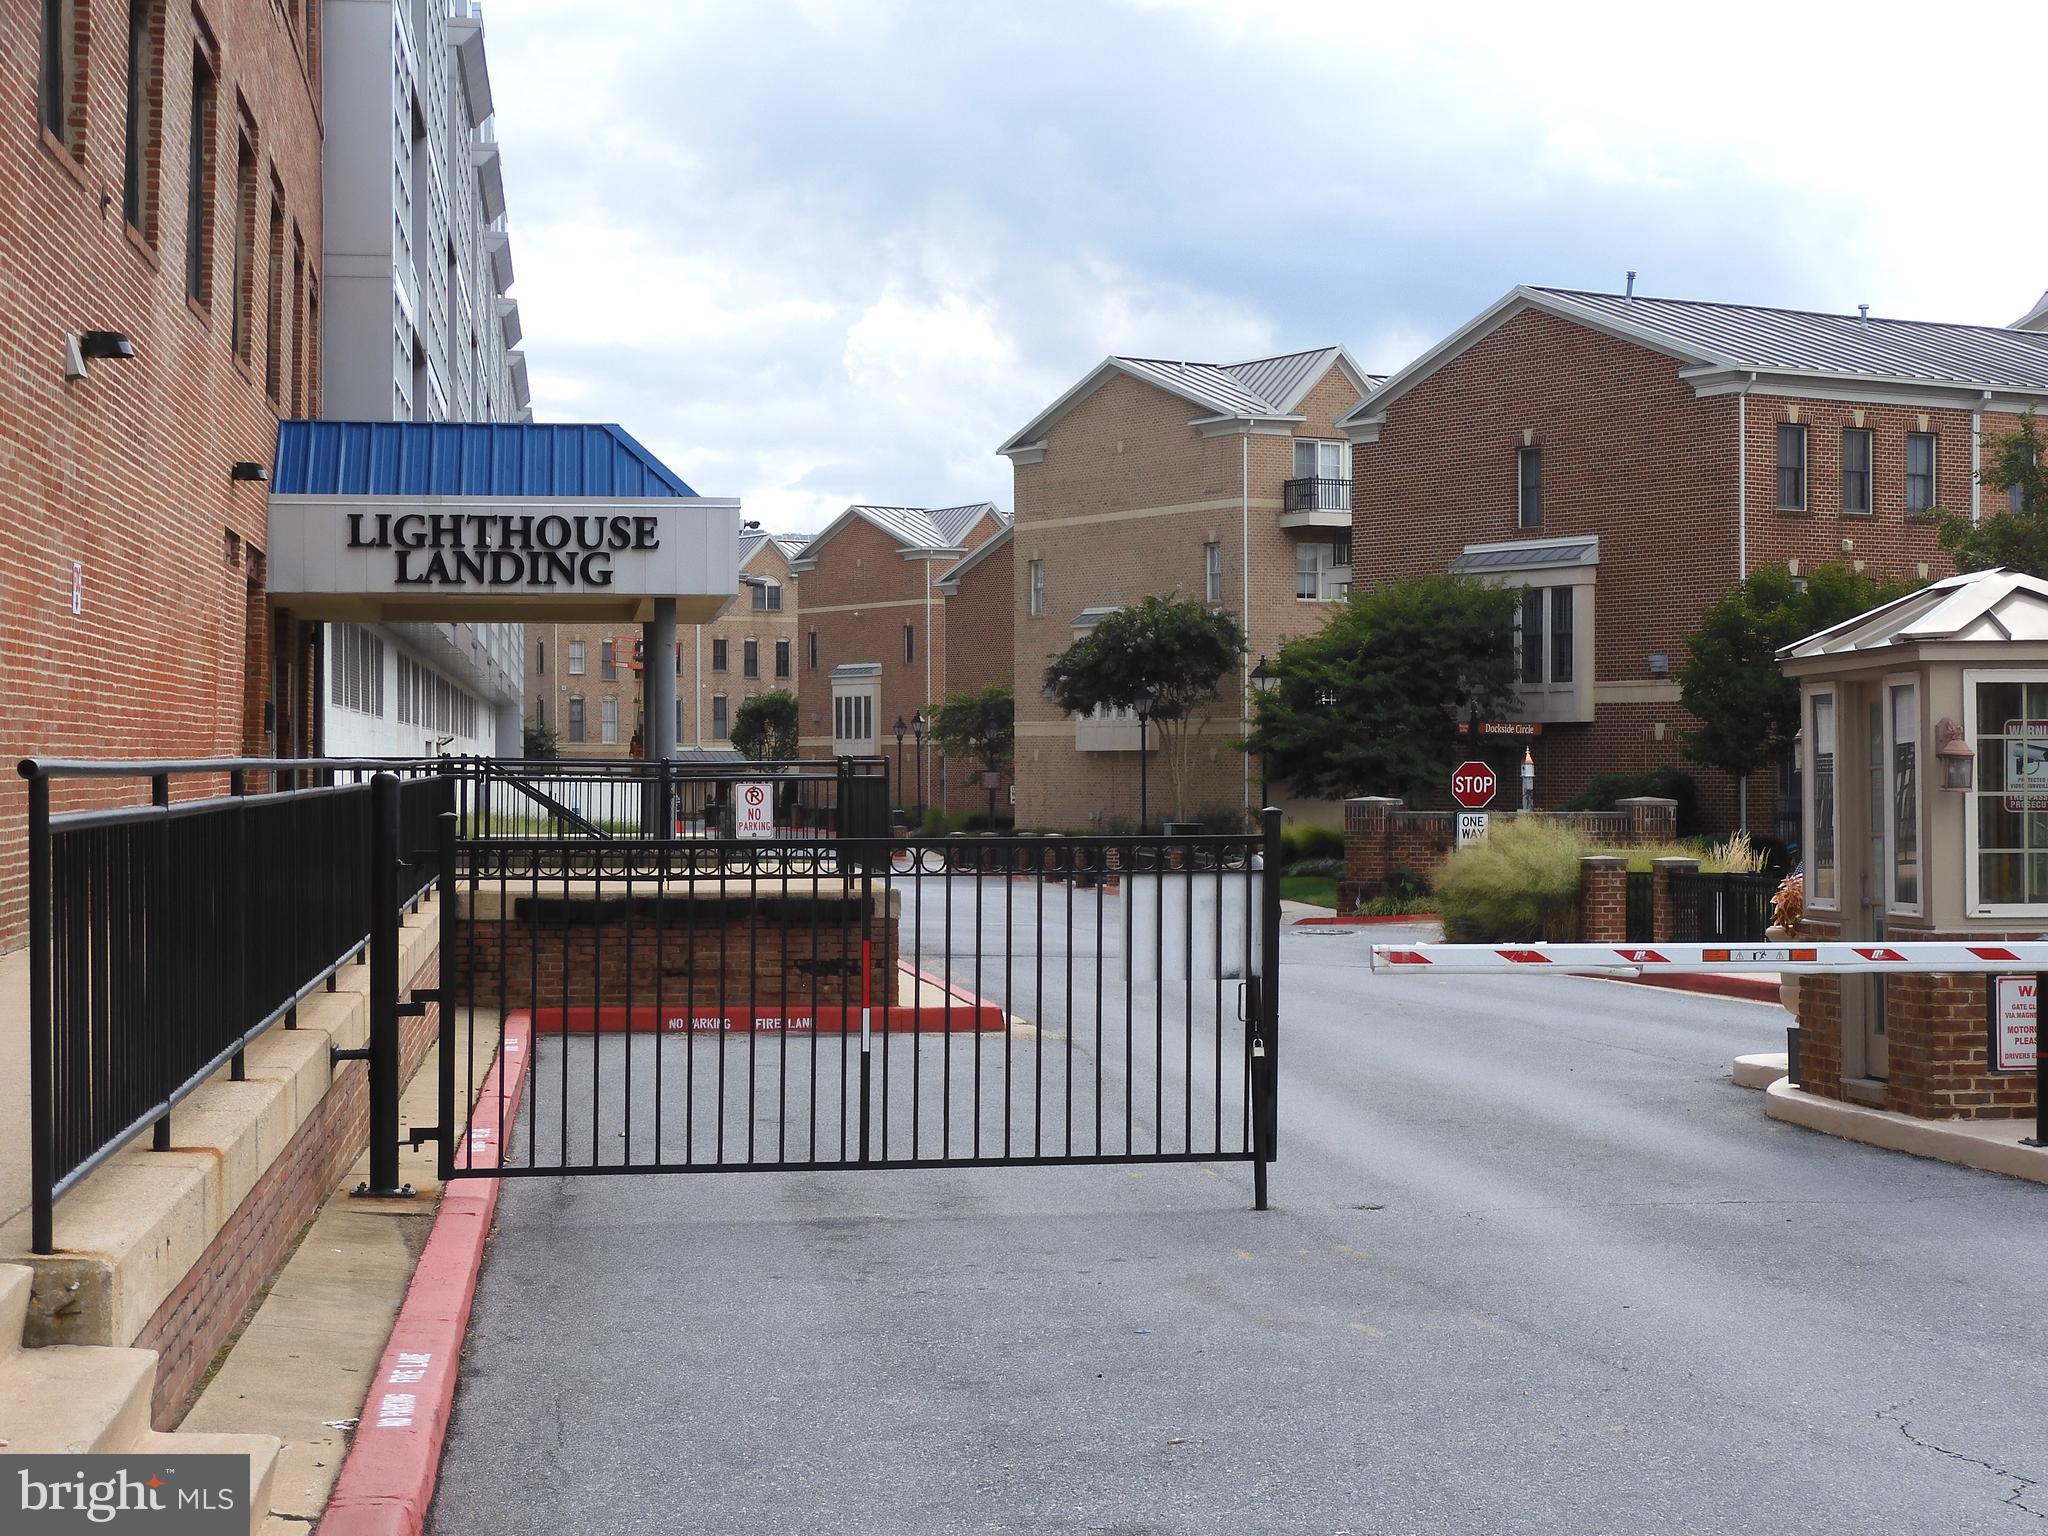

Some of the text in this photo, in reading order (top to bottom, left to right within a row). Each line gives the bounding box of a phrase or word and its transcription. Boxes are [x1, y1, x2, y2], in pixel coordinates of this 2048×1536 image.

[347, 513, 661, 550] LIGHTHOUSE
[393, 550, 614, 586] LANDING
[1485, 723, 1534, 734] Dockside Circle
[1455, 776, 1492, 793] STOP
[748, 808, 761, 821] NO
[739, 822, 771, 831] PARKING
[1462, 816, 1484, 827] ONE
[1462, 828, 1485, 839] WAY
[668, 1018, 684, 1029] NO
[755, 1018, 781, 1030] FIRE
[788, 1017, 813, 1029] LAN
[2004, 1052, 2031, 1060] DRIVERS
